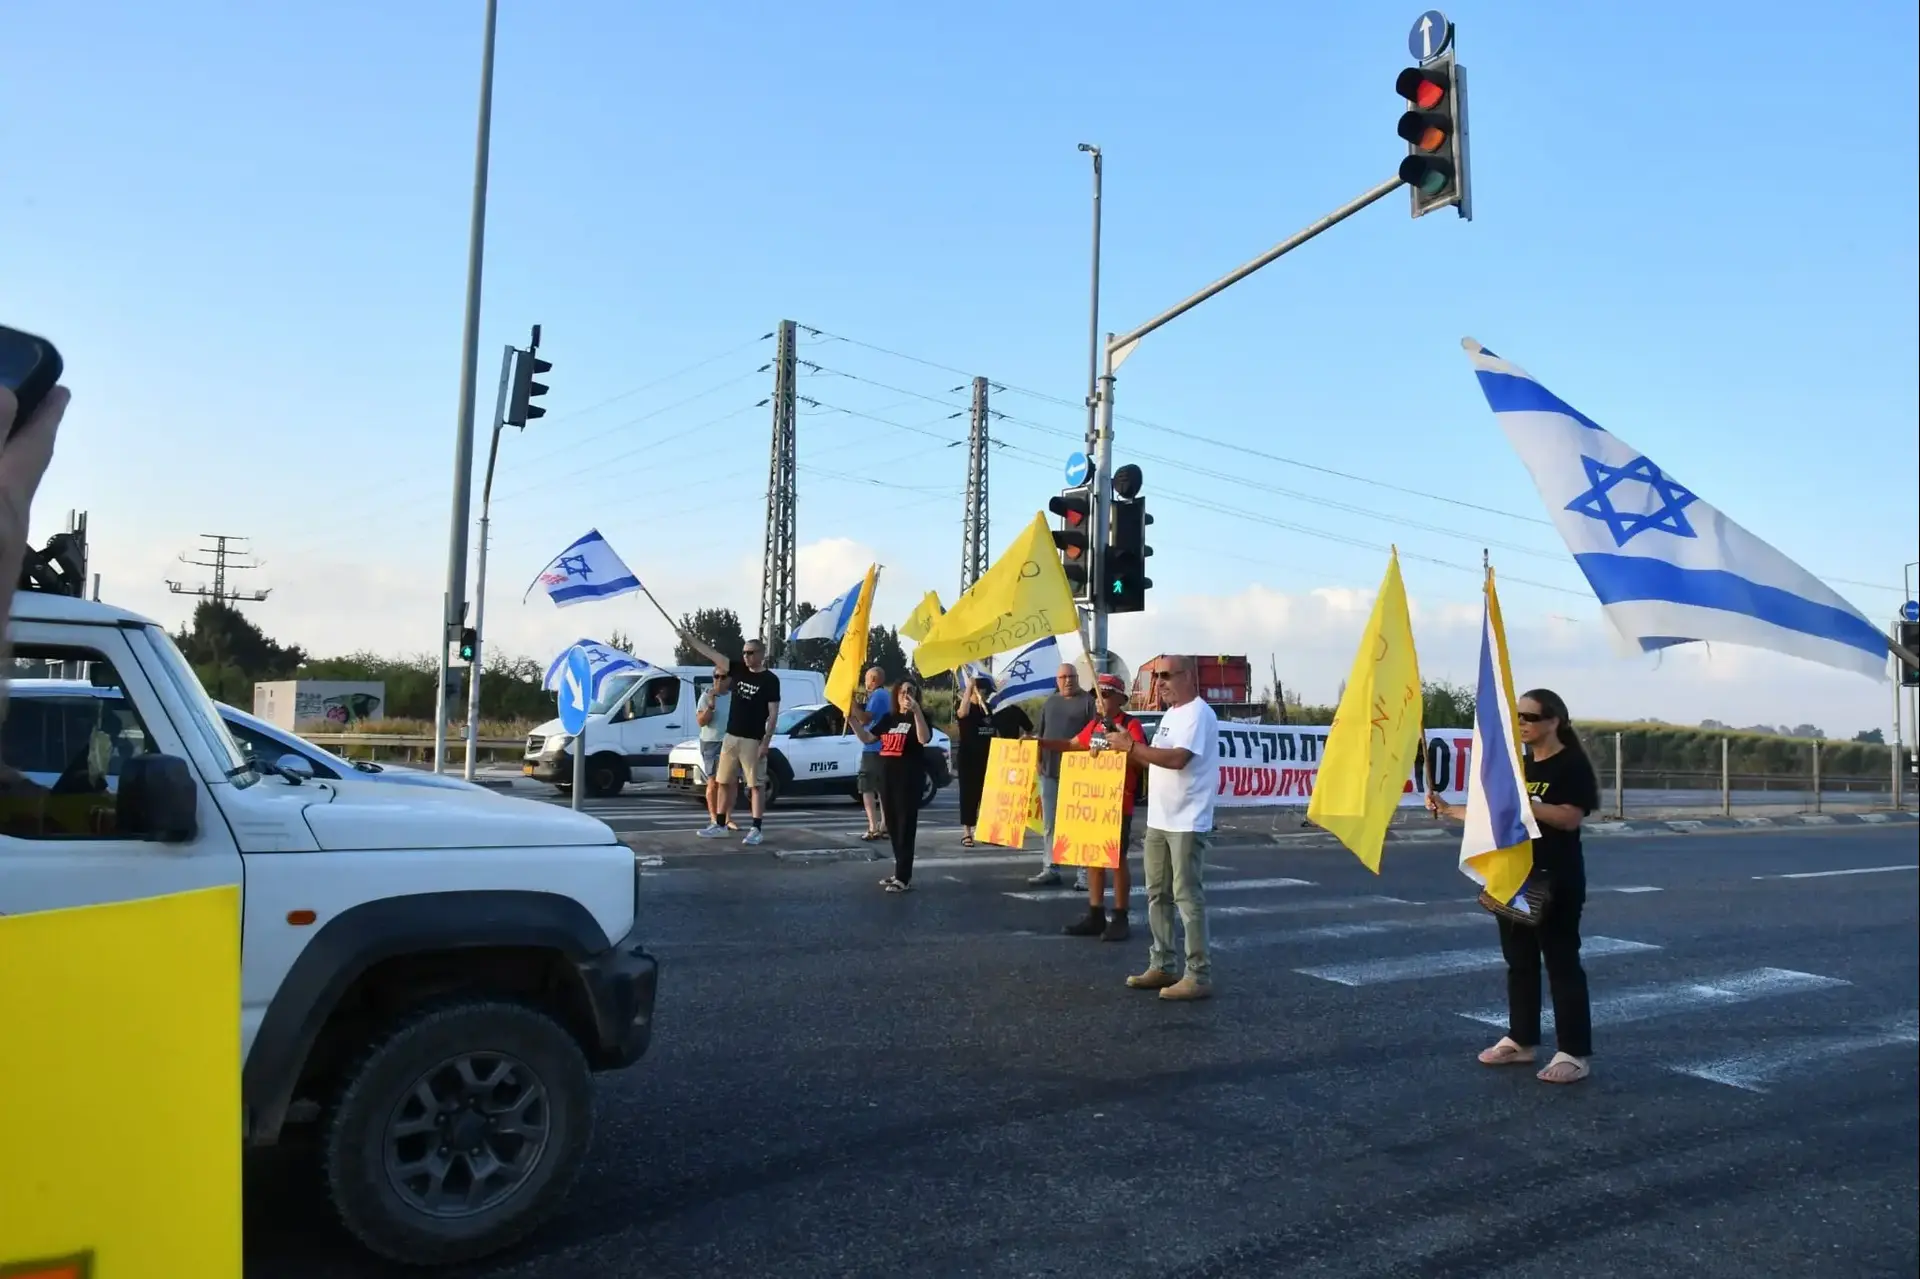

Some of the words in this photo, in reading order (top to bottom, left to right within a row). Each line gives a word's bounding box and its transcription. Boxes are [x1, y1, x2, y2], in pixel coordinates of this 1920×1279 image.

[1218, 730, 1296, 763] חקירה
[1109, 779, 1123, 803] לא
[1217, 766, 1277, 796] עכשיו
[1276, 768, 1318, 796] חית
[1065, 800, 1098, 822] נסלח
[1101, 803, 1121, 827] ולא
